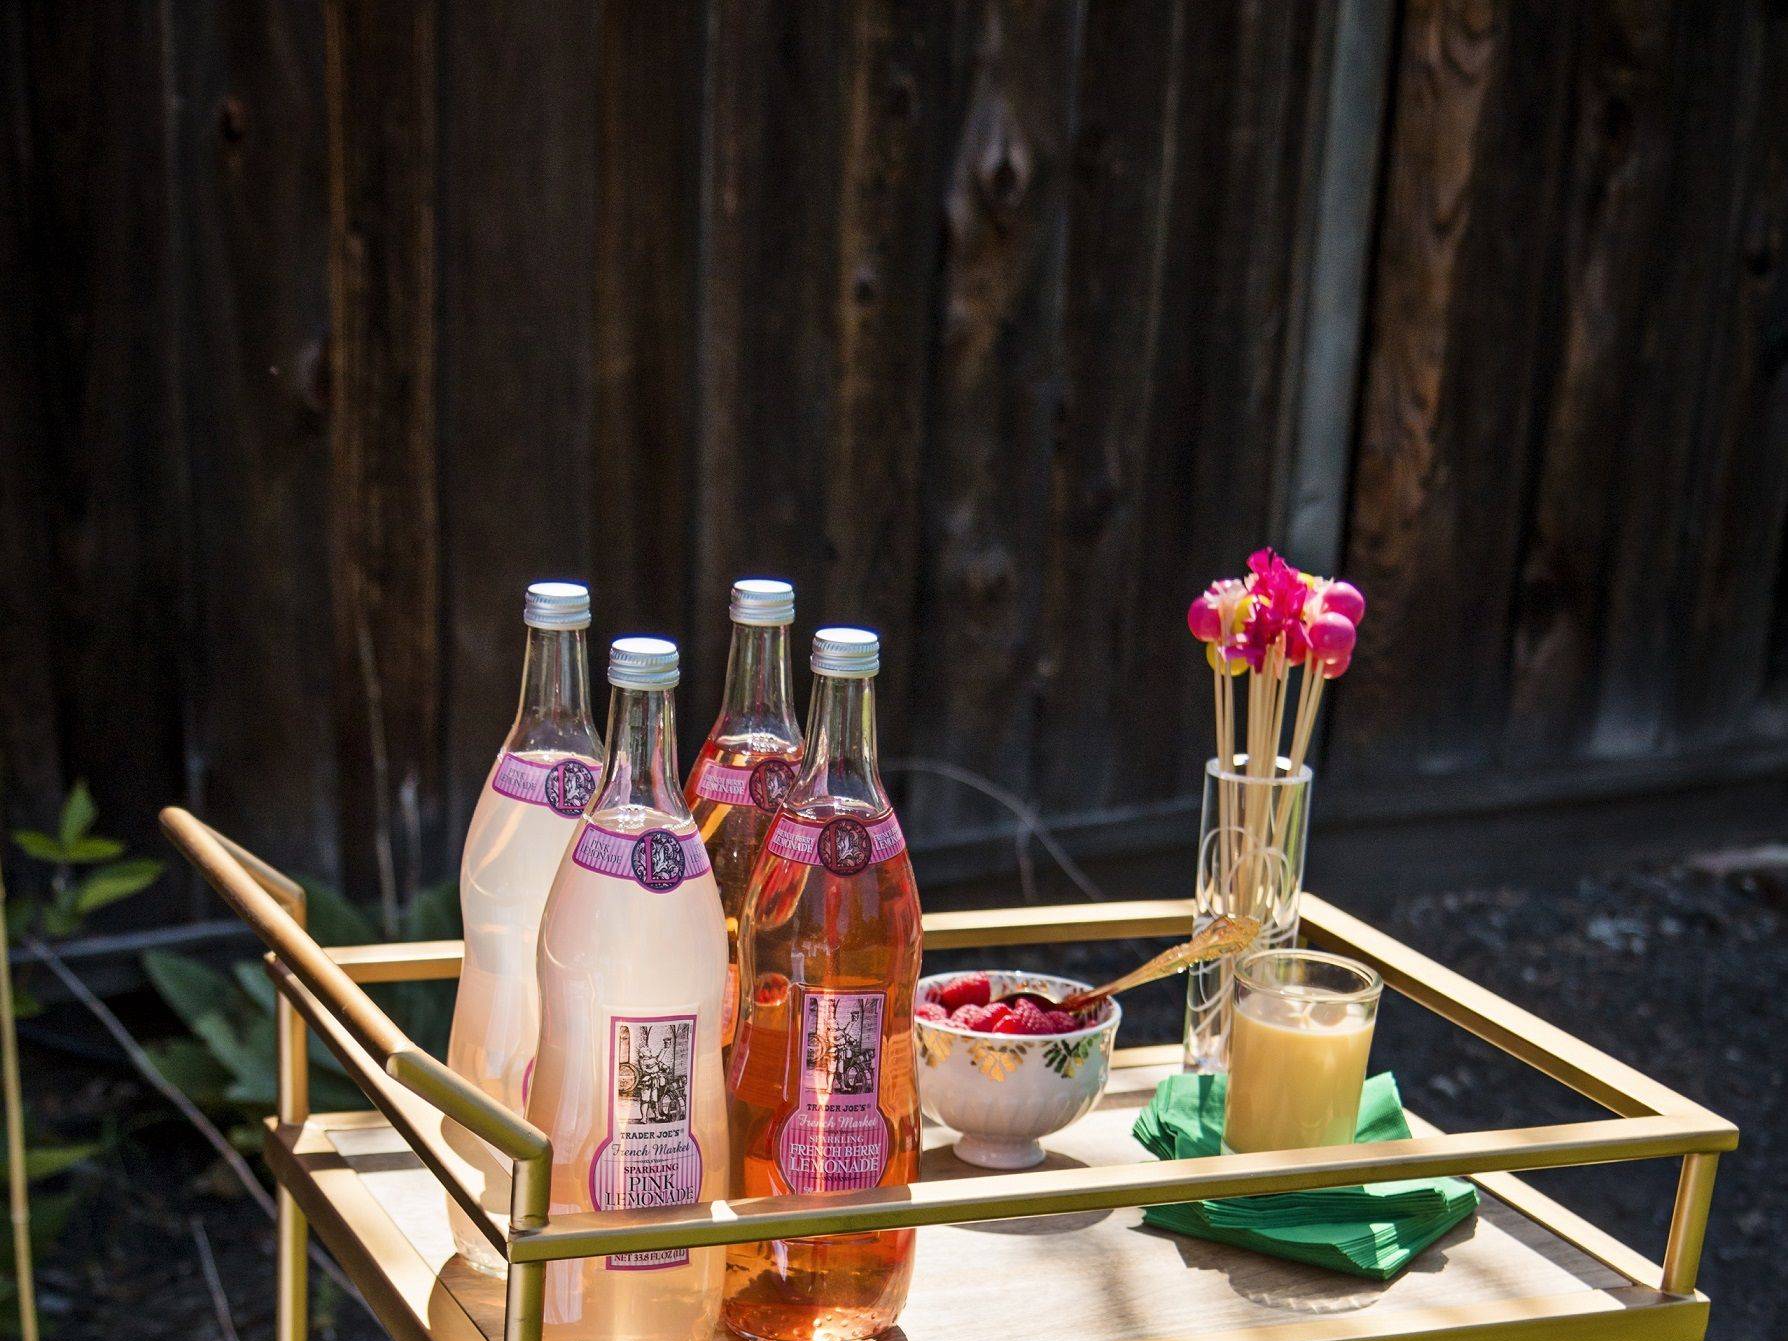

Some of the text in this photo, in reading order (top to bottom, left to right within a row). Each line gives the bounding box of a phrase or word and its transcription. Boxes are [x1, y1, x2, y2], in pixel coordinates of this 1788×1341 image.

[580, 843, 623, 864] LEMONADE
[591, 839, 611, 853] PINK
[806, 1103, 840, 1112] TRADER
[798, 1113, 878, 1128] French Market
[620, 1131, 655, 1140] TRADER
[809, 1134, 864, 1144] SPARKLING
[652, 1141, 690, 1156] Market
[790, 1142, 881, 1158] FRENCH BERRY
[623, 1162, 679, 1175] SPARKLING
[789, 1155, 879, 1174] LEMONADE
[629, 1173, 676, 1192] PINK
[604, 1185, 695, 1207] LEMONADE
